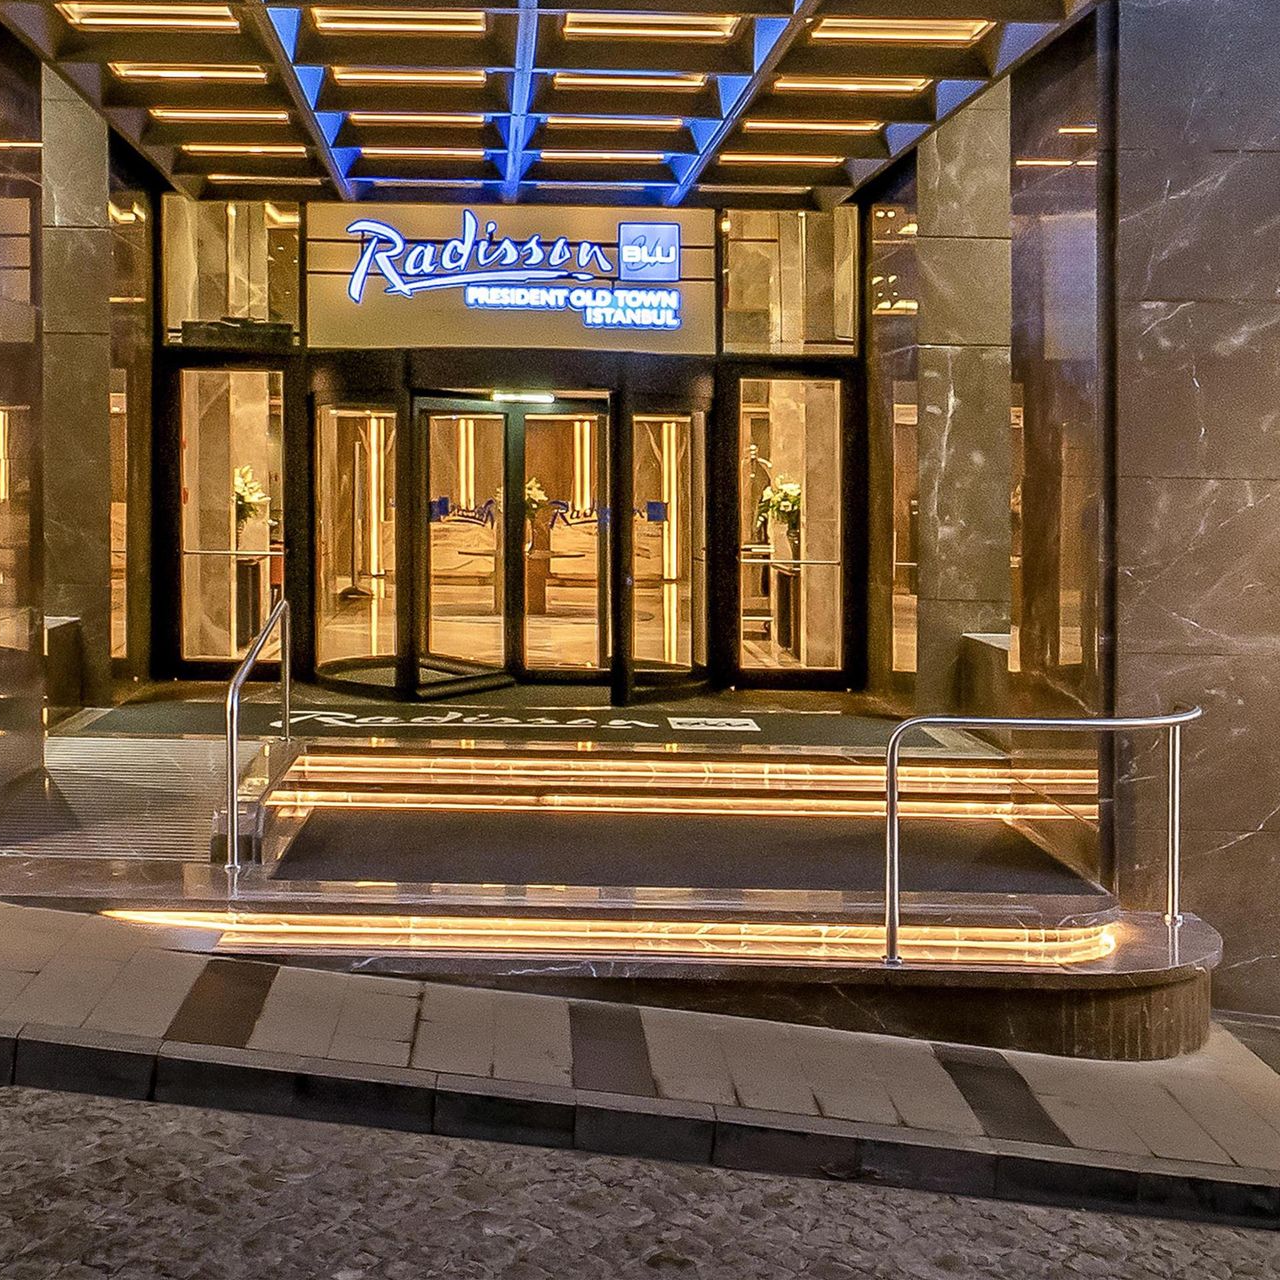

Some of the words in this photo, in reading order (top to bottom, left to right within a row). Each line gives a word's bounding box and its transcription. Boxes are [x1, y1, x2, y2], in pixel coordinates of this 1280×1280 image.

[346, 209, 613, 303] Radisson
[622, 244, 677, 265] BLU
[466, 286, 569, 306] PRESIDENT
[570, 287, 611, 307] OLD
[613, 288, 678, 309] TOWN
[586, 307, 679, 326] ISTANBUL
